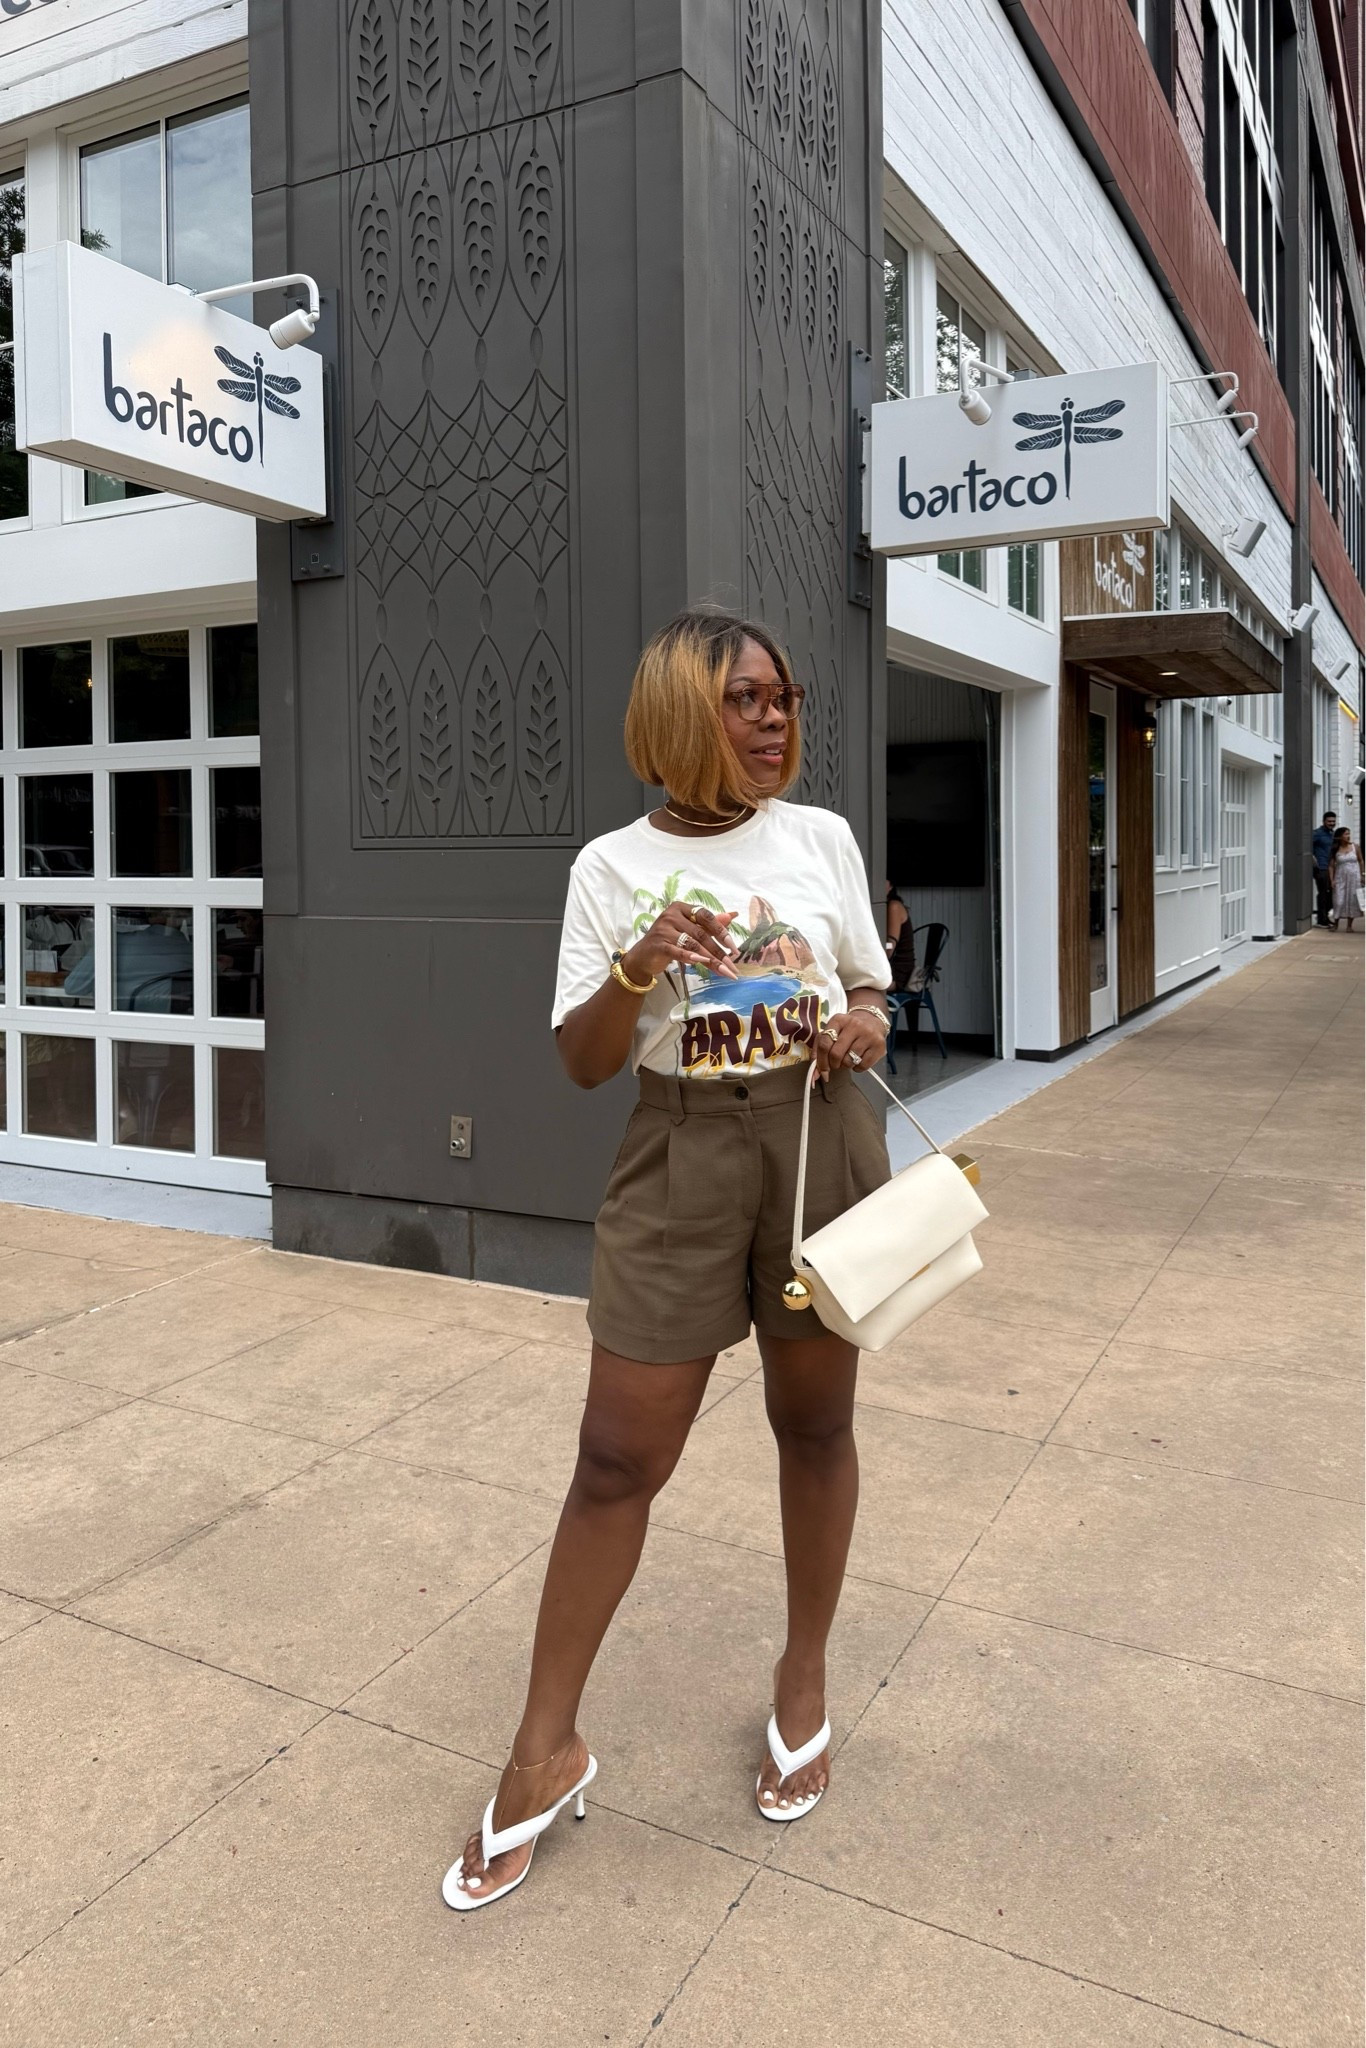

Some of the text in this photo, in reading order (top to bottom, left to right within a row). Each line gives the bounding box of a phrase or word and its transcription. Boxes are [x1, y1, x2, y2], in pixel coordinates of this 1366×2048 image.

[103, 332, 253, 463] bartaco
[898, 455, 1057, 520] bartaco
[1094, 536, 1132, 609] bartaco
